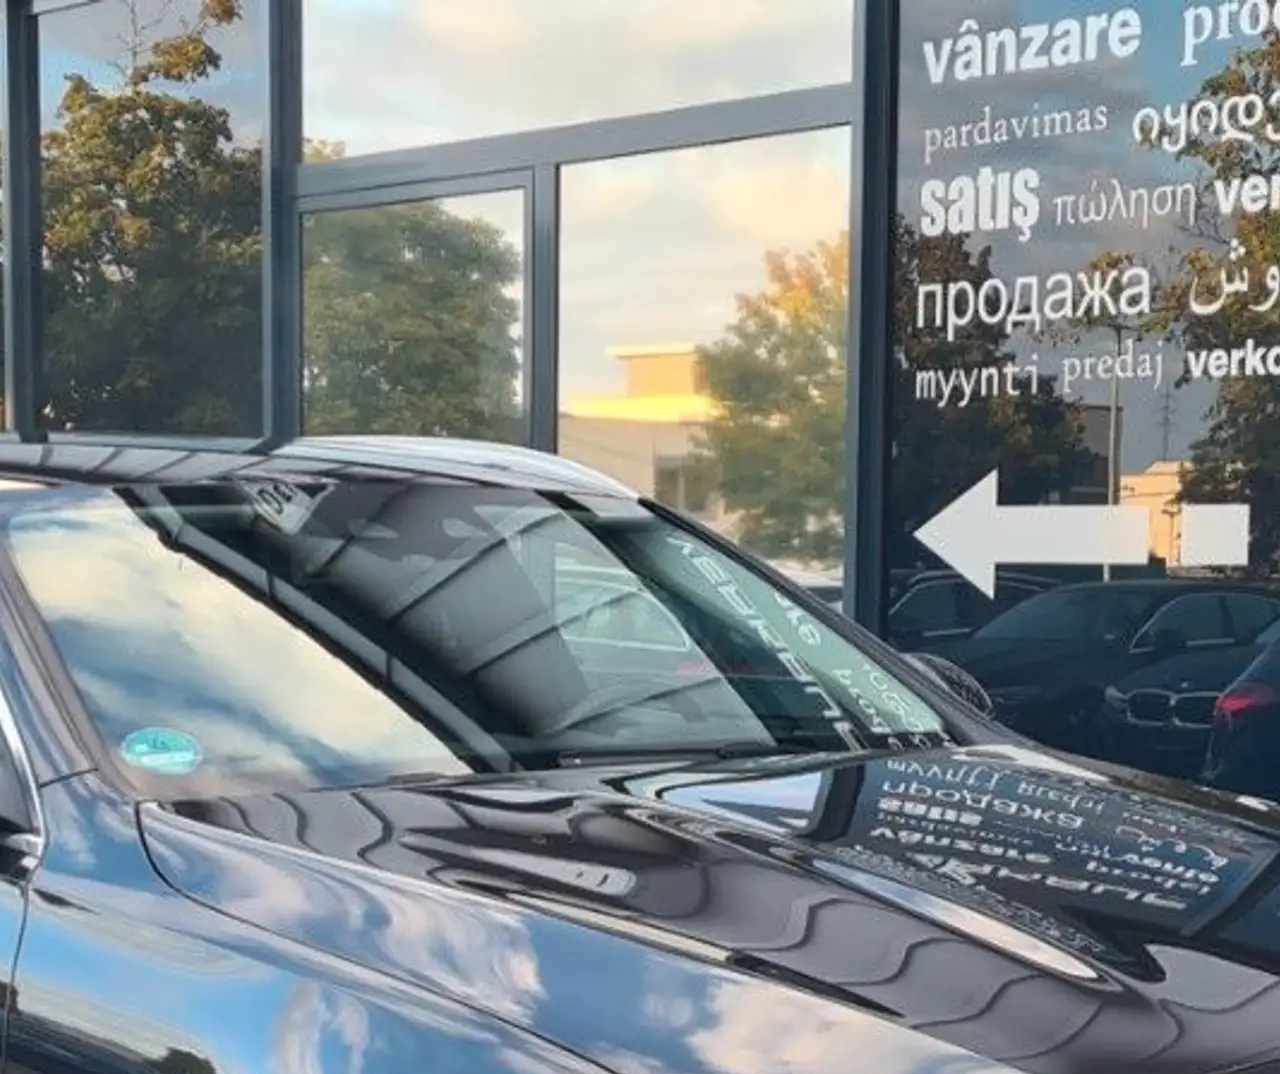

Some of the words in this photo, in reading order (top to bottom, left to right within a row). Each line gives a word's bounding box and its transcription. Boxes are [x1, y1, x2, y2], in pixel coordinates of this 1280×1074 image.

[923, 8, 1141, 83] vânzare
[924, 101, 1108, 164] pardavimas
[920, 166, 1040, 241] satış
[1054, 180, 1196, 228] πώληση
[917, 265, 1151, 342] продажа
[916, 353, 1039, 407] myynti
[1063, 338, 1163, 390] predaj
